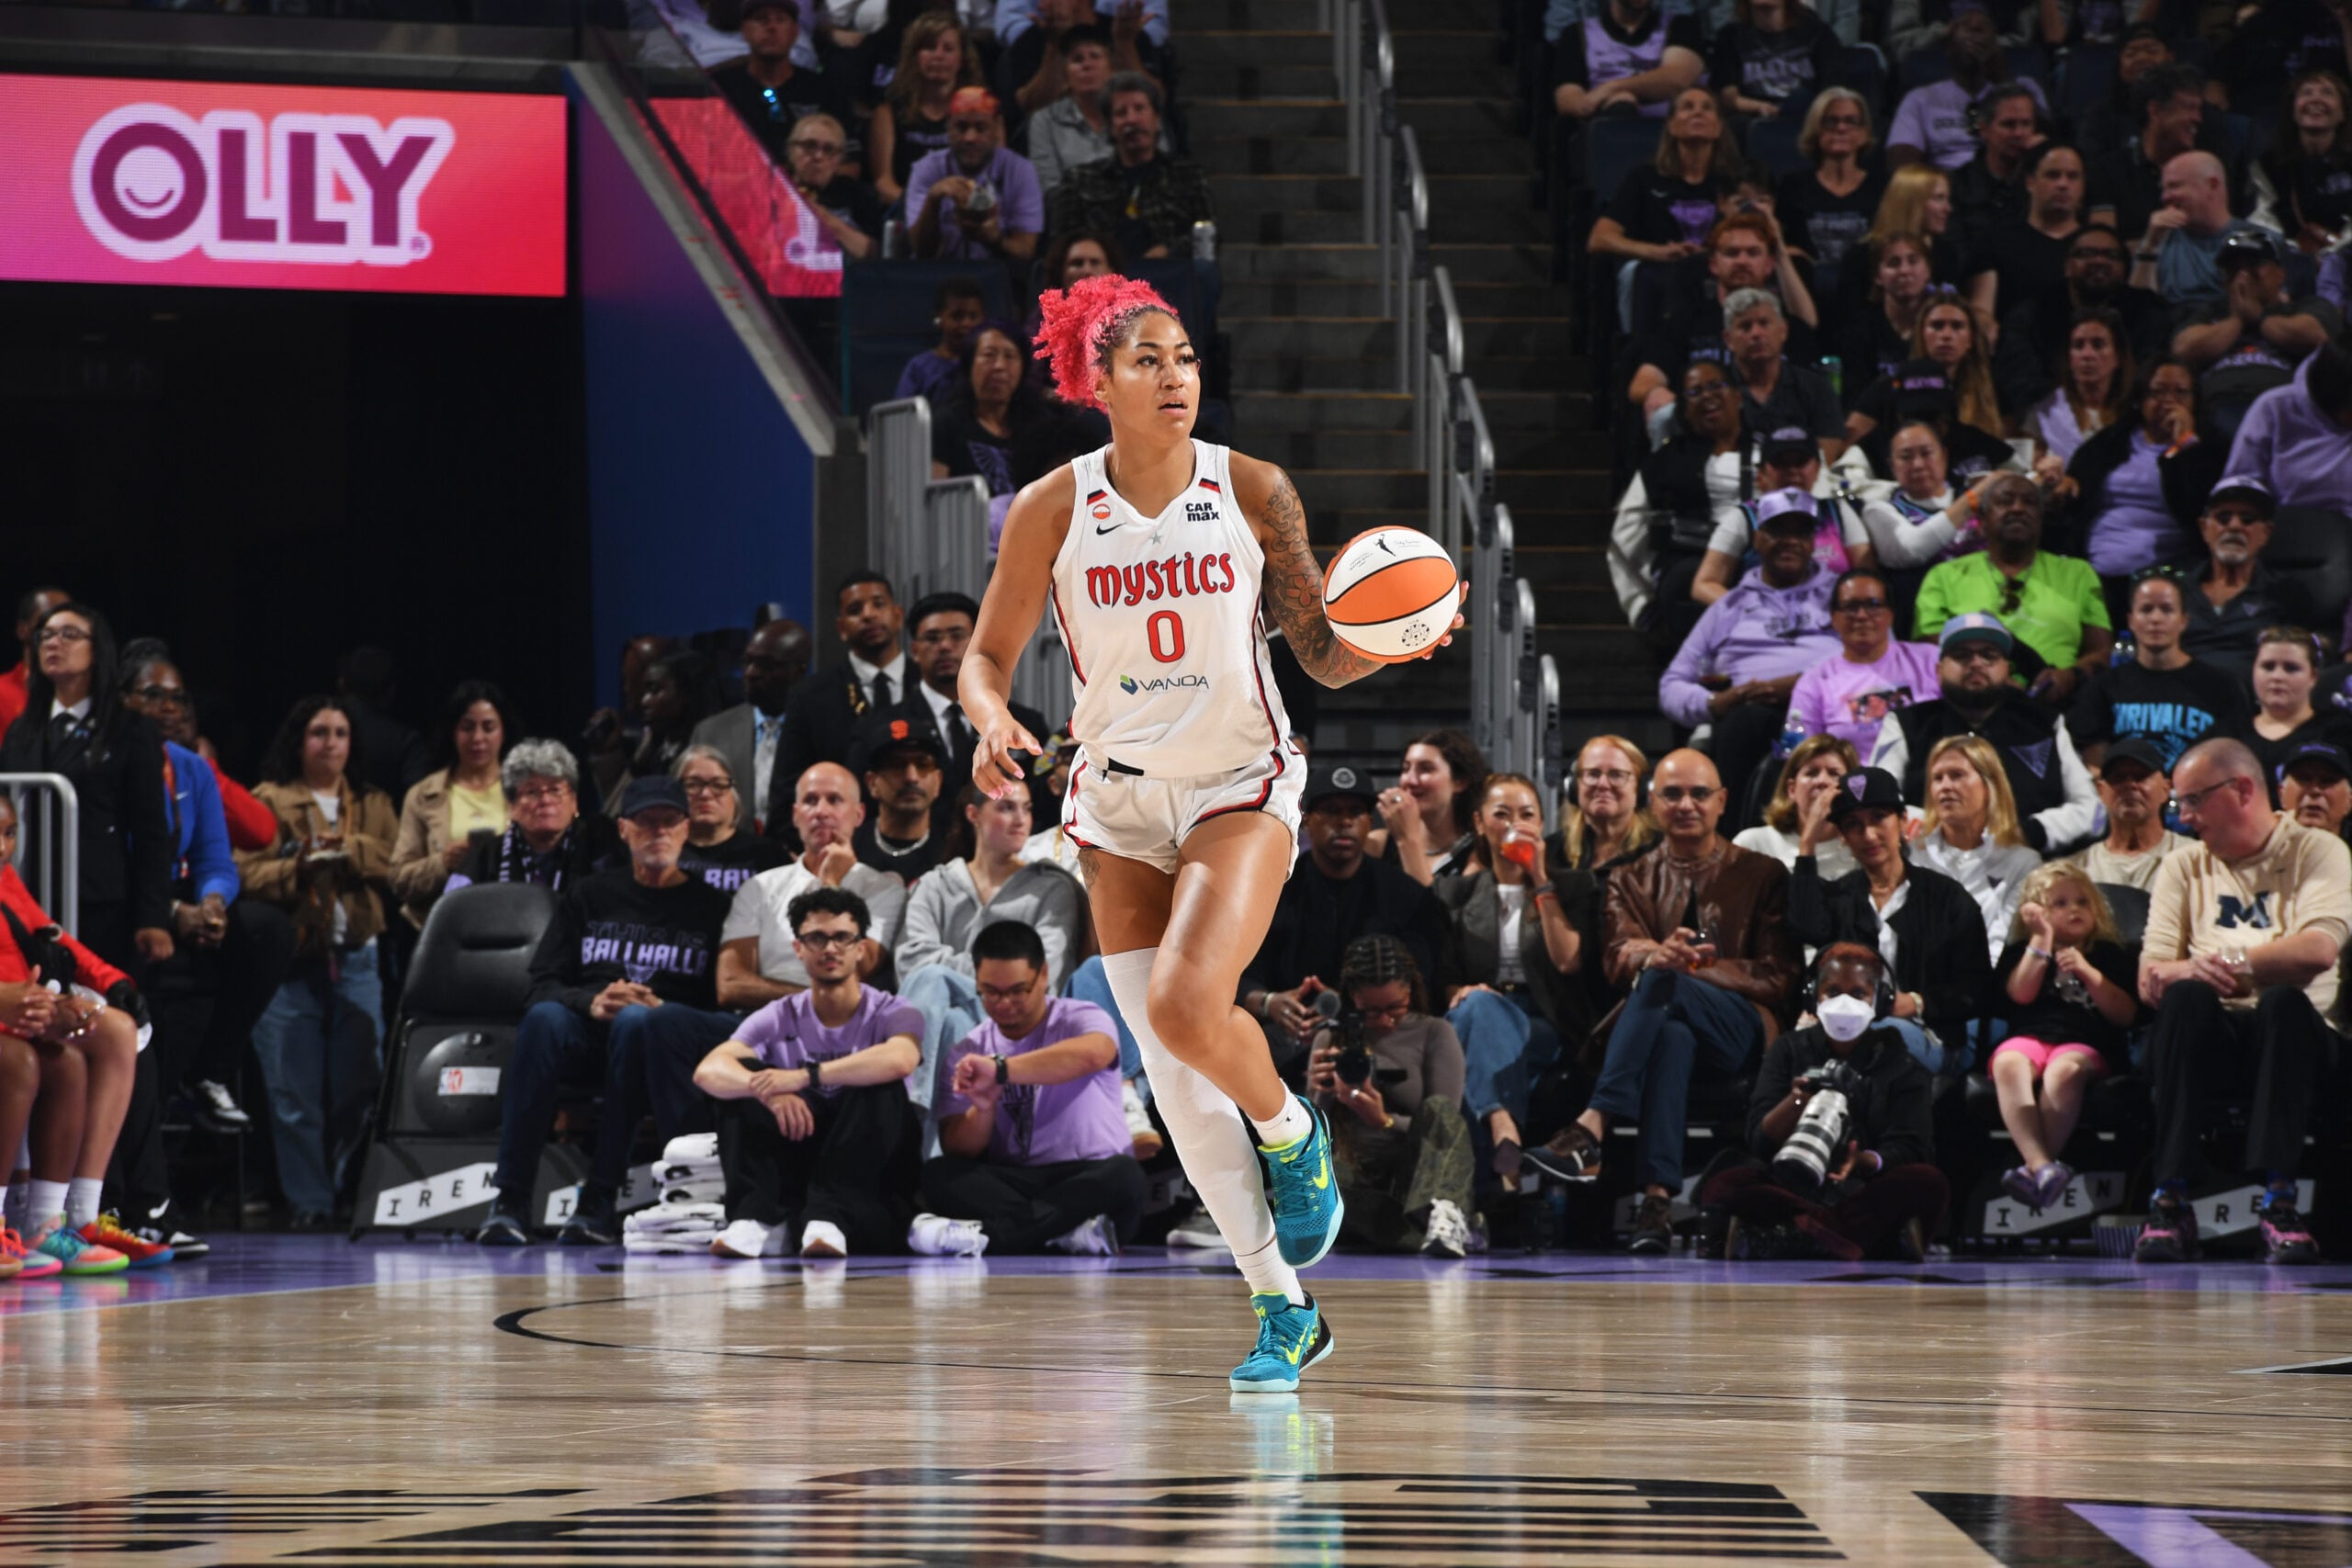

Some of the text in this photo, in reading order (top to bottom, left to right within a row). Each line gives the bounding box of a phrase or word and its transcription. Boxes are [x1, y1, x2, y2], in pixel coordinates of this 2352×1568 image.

[90, 120, 436, 247] OLLY
[1185, 502, 1213, 512] CAR
[1187, 511, 1220, 522] max
[1085, 551, 1235, 609] mystics
[1147, 610, 1185, 663] 0
[1139, 674, 1209, 691] VANDA
[2214, 890, 2270, 929] M
